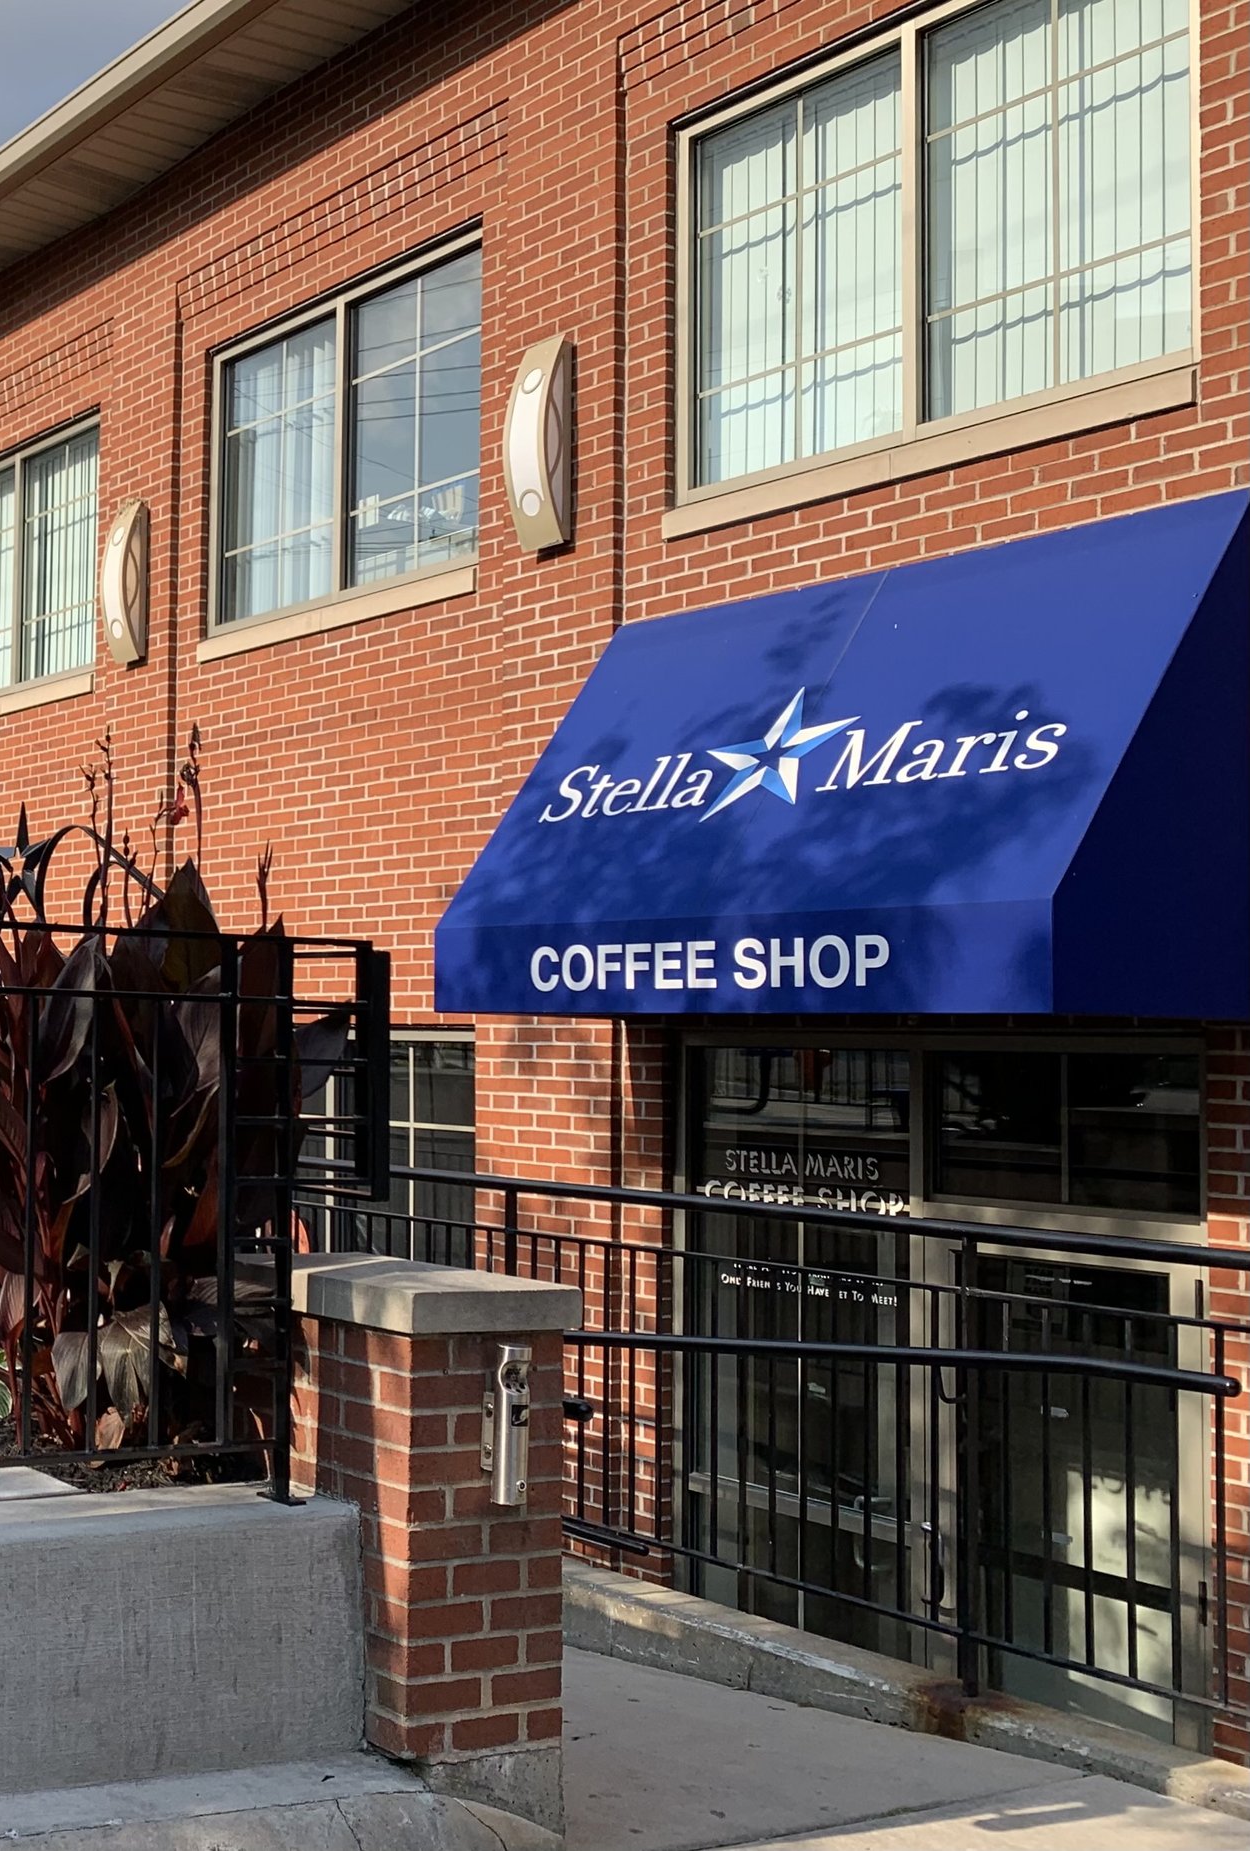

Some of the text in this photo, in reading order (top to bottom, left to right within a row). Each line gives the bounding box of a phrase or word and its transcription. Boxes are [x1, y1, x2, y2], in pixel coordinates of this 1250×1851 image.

[538, 710, 1068, 823] Stella Maris
[530, 934, 890, 992] COFFEE SHOP
[725, 1149, 879, 1181] STELLA MARIS
